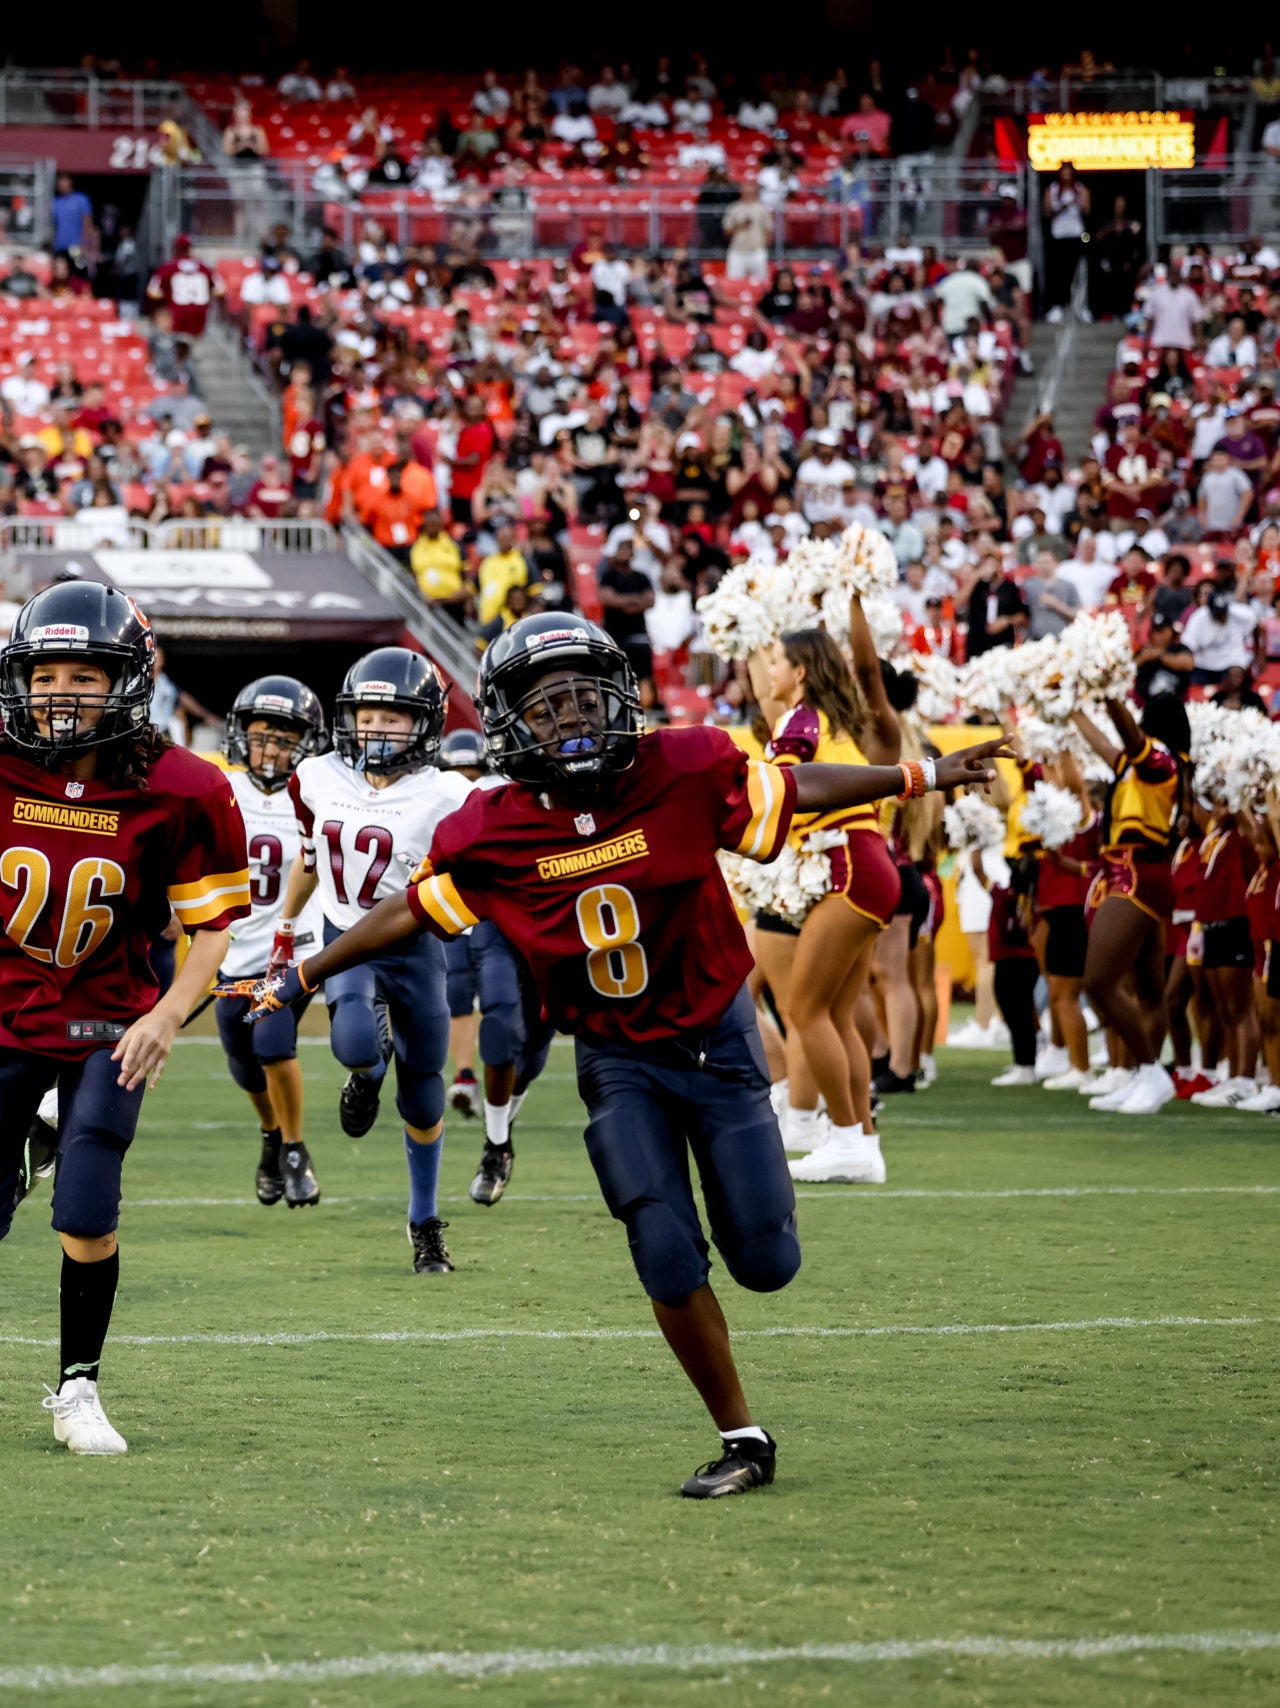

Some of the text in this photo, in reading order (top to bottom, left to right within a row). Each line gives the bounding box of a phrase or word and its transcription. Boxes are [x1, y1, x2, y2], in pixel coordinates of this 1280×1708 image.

[45, 626, 77, 636] Riddell
[539, 631, 572, 642] Riddell
[13, 802, 119, 832] COMMANDERS
[249, 834, 283, 906] 3
[321, 819, 394, 910] 12
[537, 834, 648, 880] COMMANDERS
[0, 846, 126, 968] 26
[575, 883, 649, 998] 8
